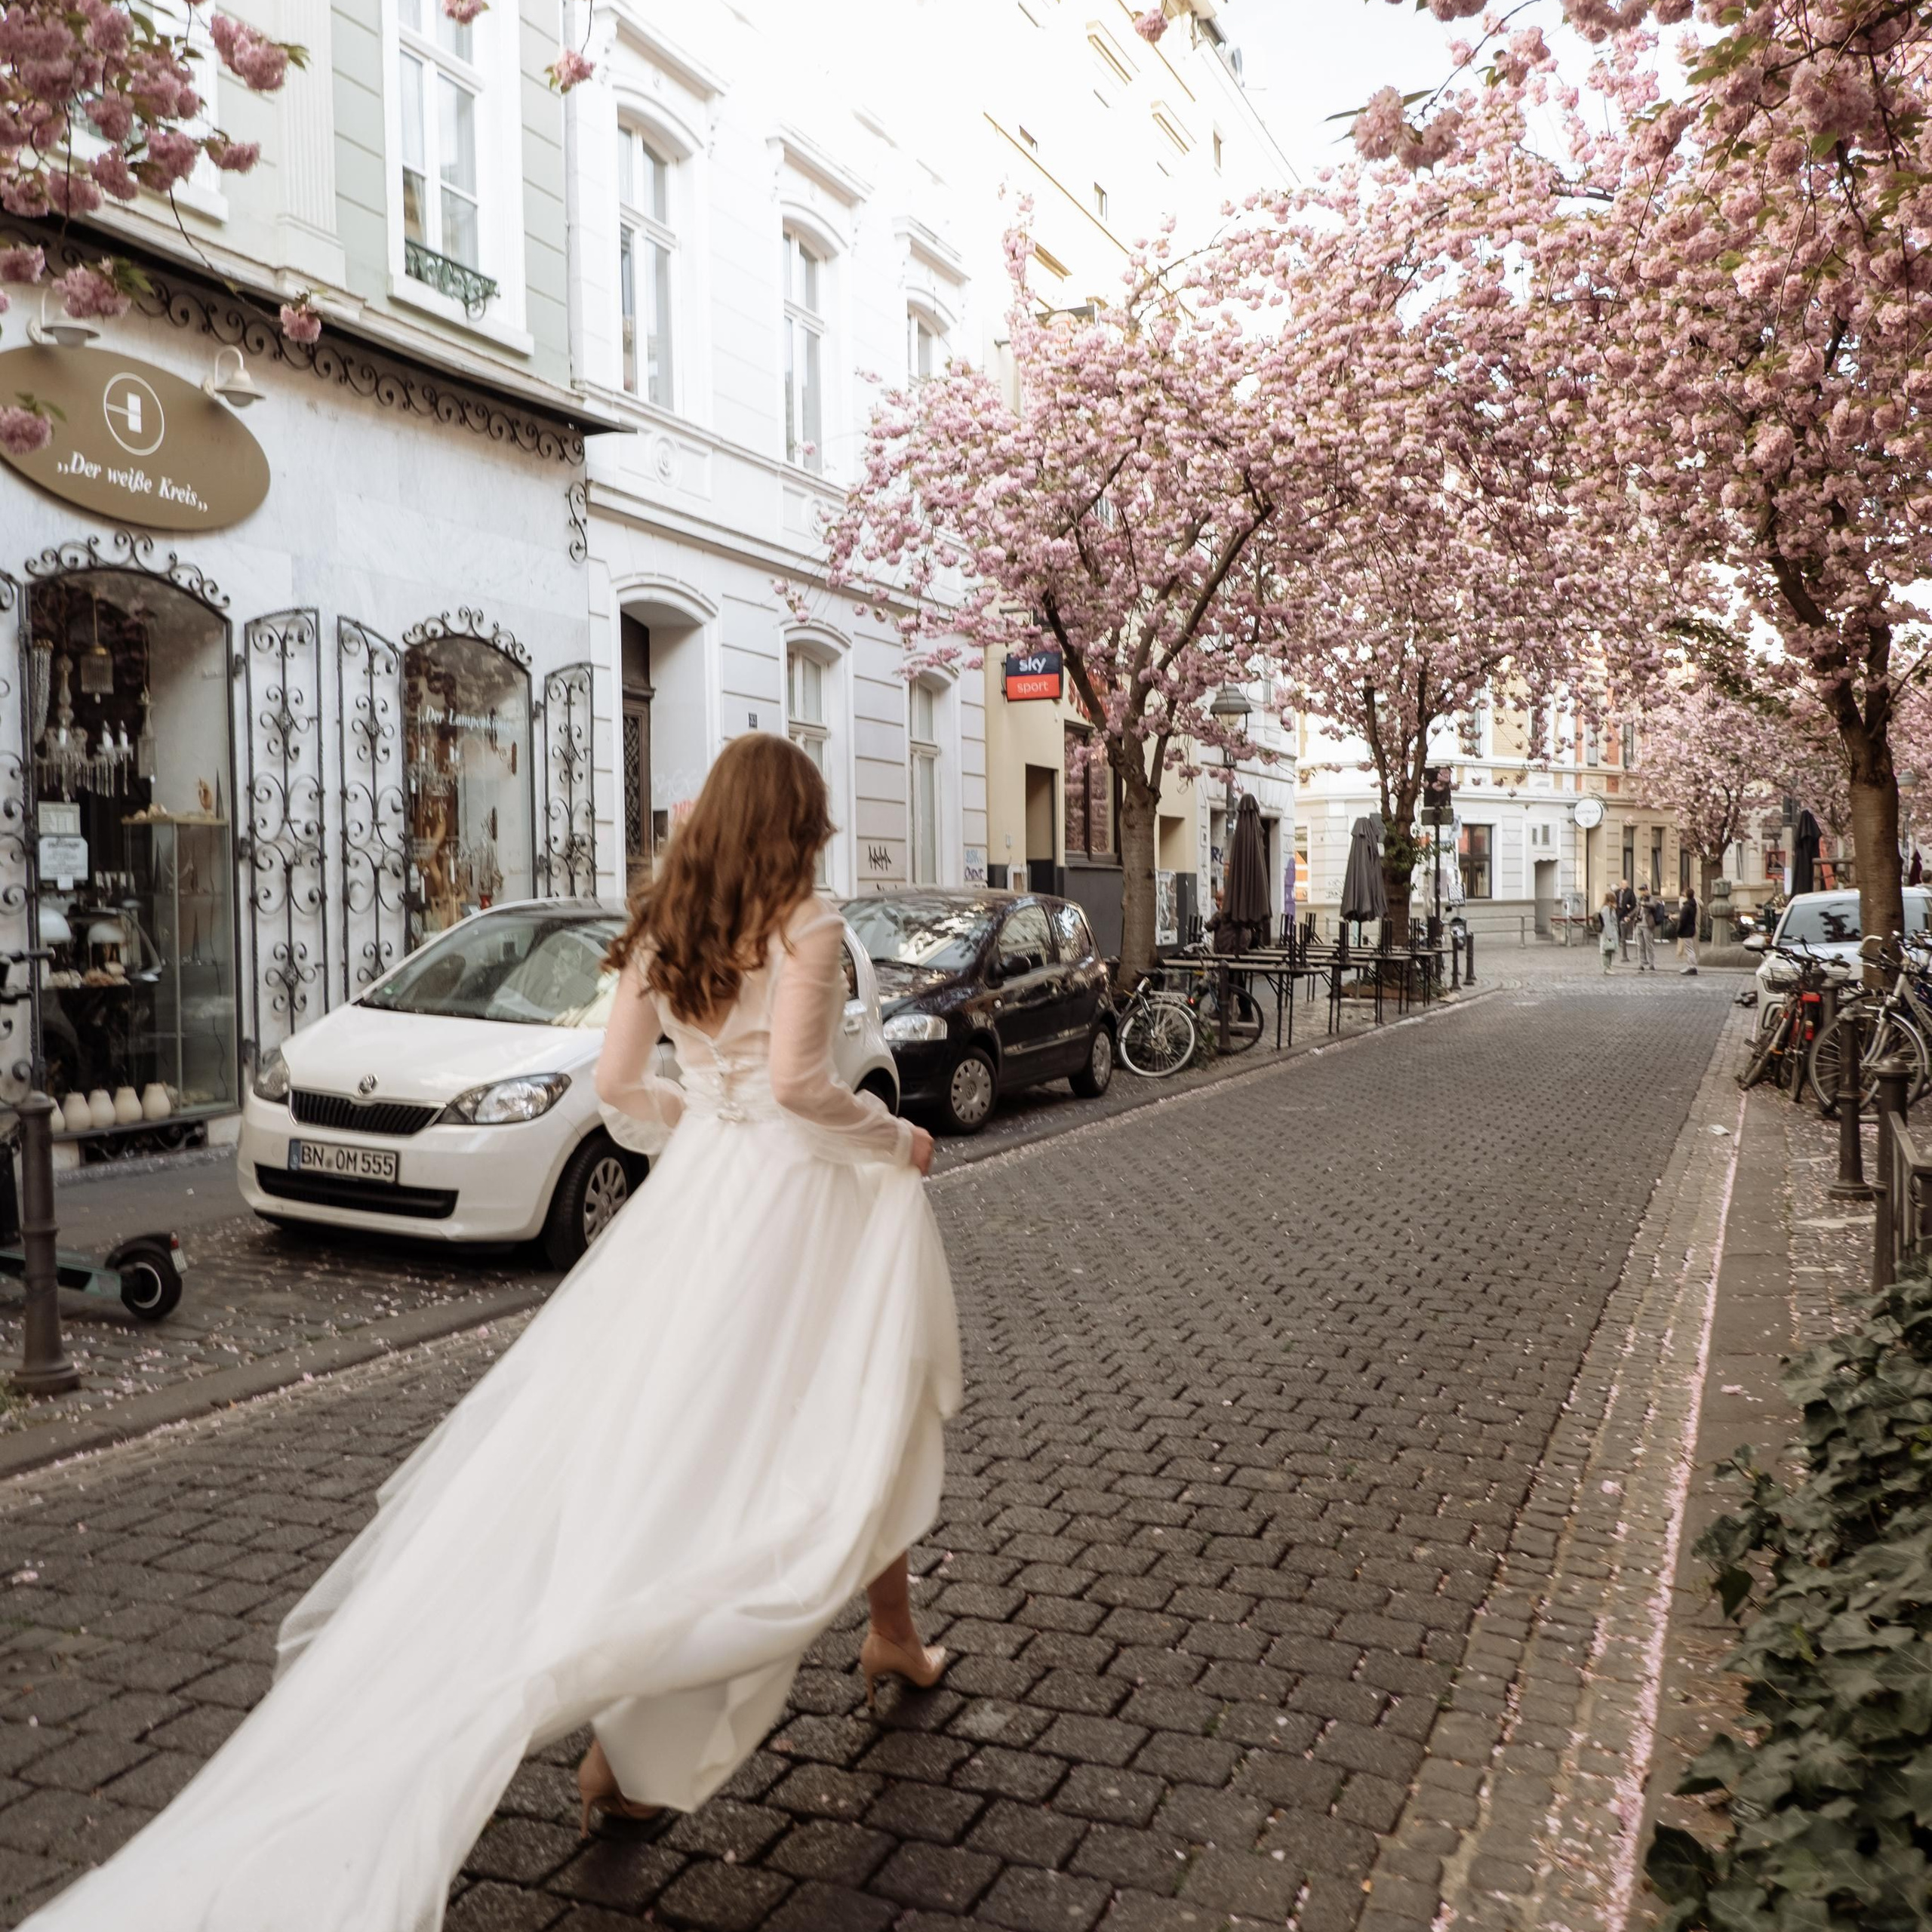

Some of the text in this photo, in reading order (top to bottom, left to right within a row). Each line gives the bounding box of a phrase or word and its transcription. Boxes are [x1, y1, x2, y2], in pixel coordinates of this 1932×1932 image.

[107, 466, 152, 494] weiße
[1019, 656, 1047, 674] sky
[1017, 681, 1049, 694] sport
[302, 1145, 394, 1177] BN OM 555
